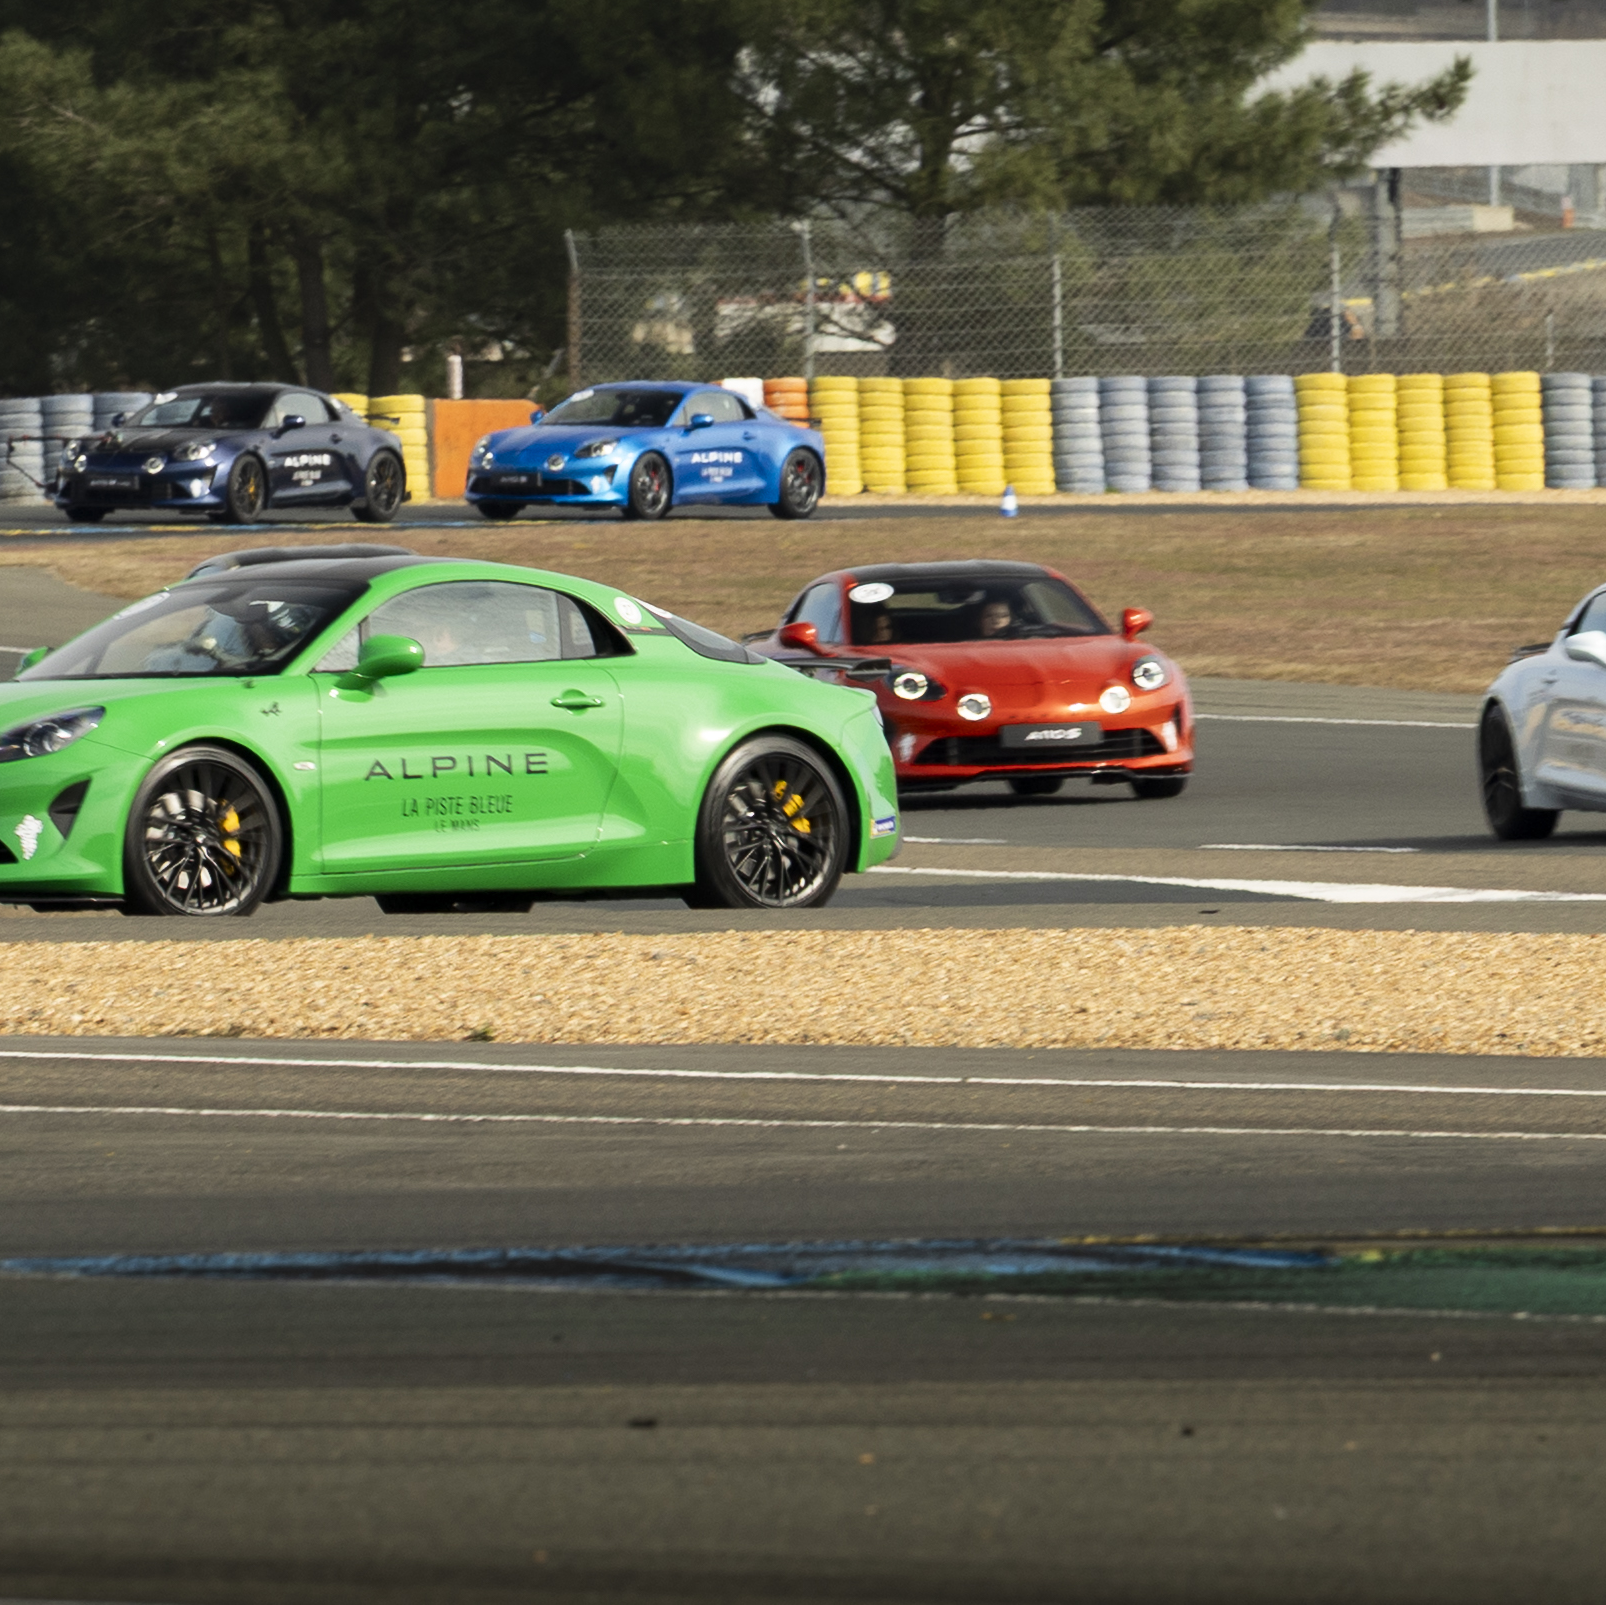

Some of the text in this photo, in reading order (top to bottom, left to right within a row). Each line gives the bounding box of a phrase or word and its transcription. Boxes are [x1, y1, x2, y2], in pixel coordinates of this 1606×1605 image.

[284, 453, 331, 467] ALPINE
[691, 451, 743, 464] ALPINE
[364, 752, 549, 781] ALPINE
[401, 794, 514, 818] LA PISTE BLEUE
